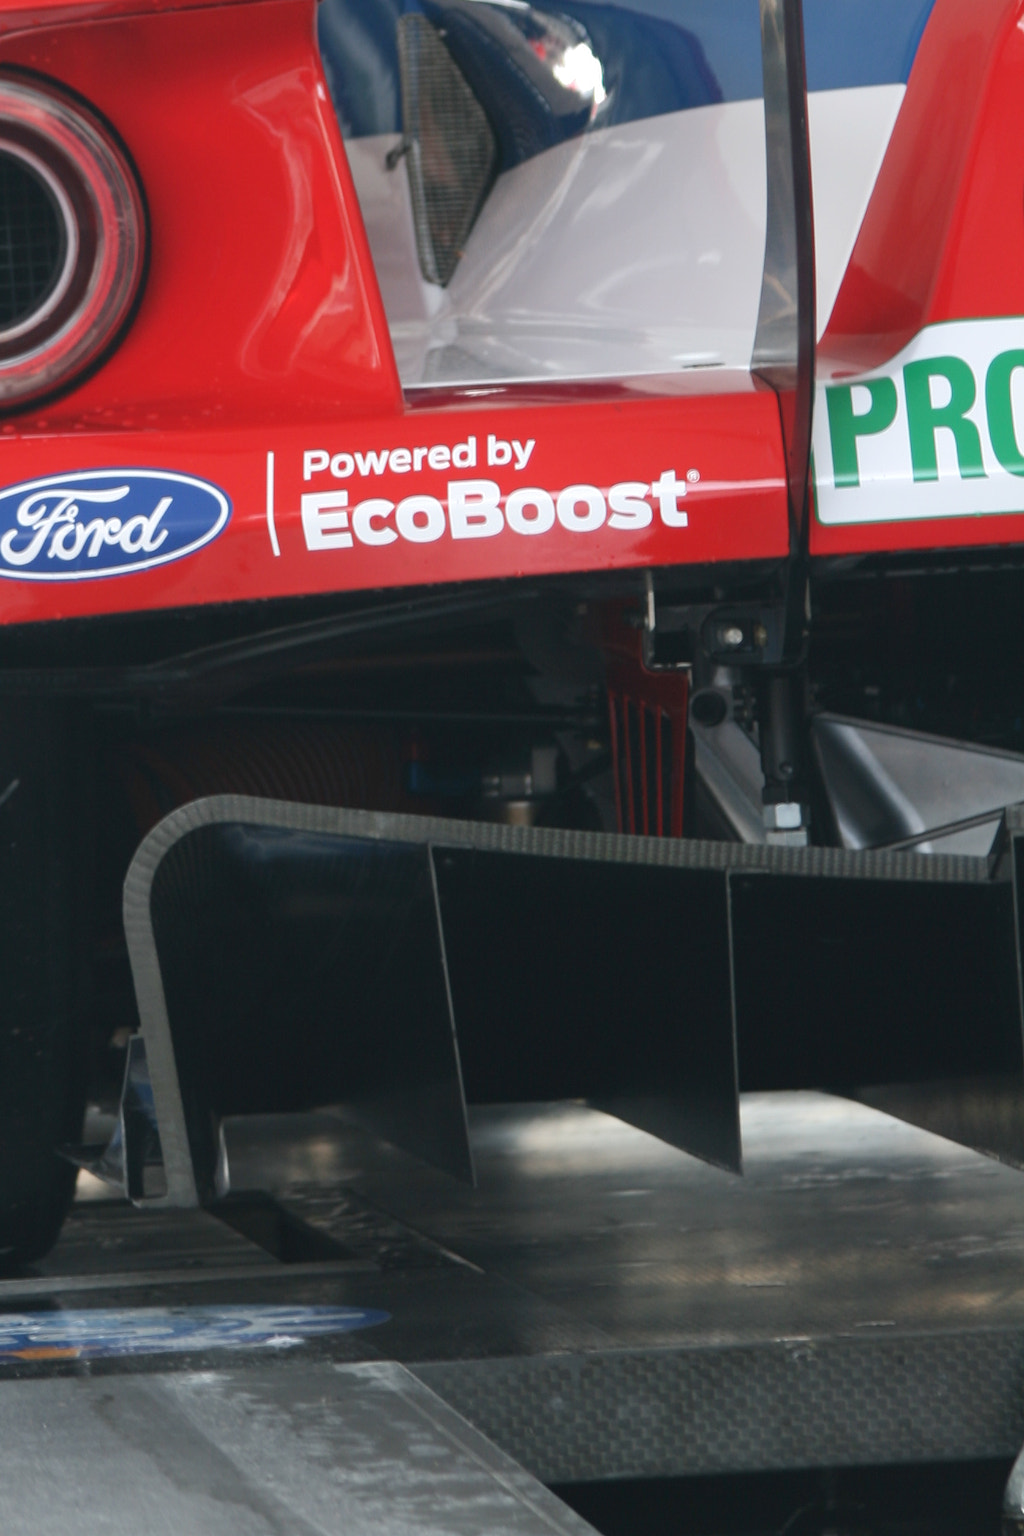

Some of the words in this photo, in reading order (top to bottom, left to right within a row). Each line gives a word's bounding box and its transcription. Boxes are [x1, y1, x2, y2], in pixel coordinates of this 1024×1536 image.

[303, 435, 477, 480] Powered
[486, 434, 536, 470] by
[0, 484, 174, 566] Ford
